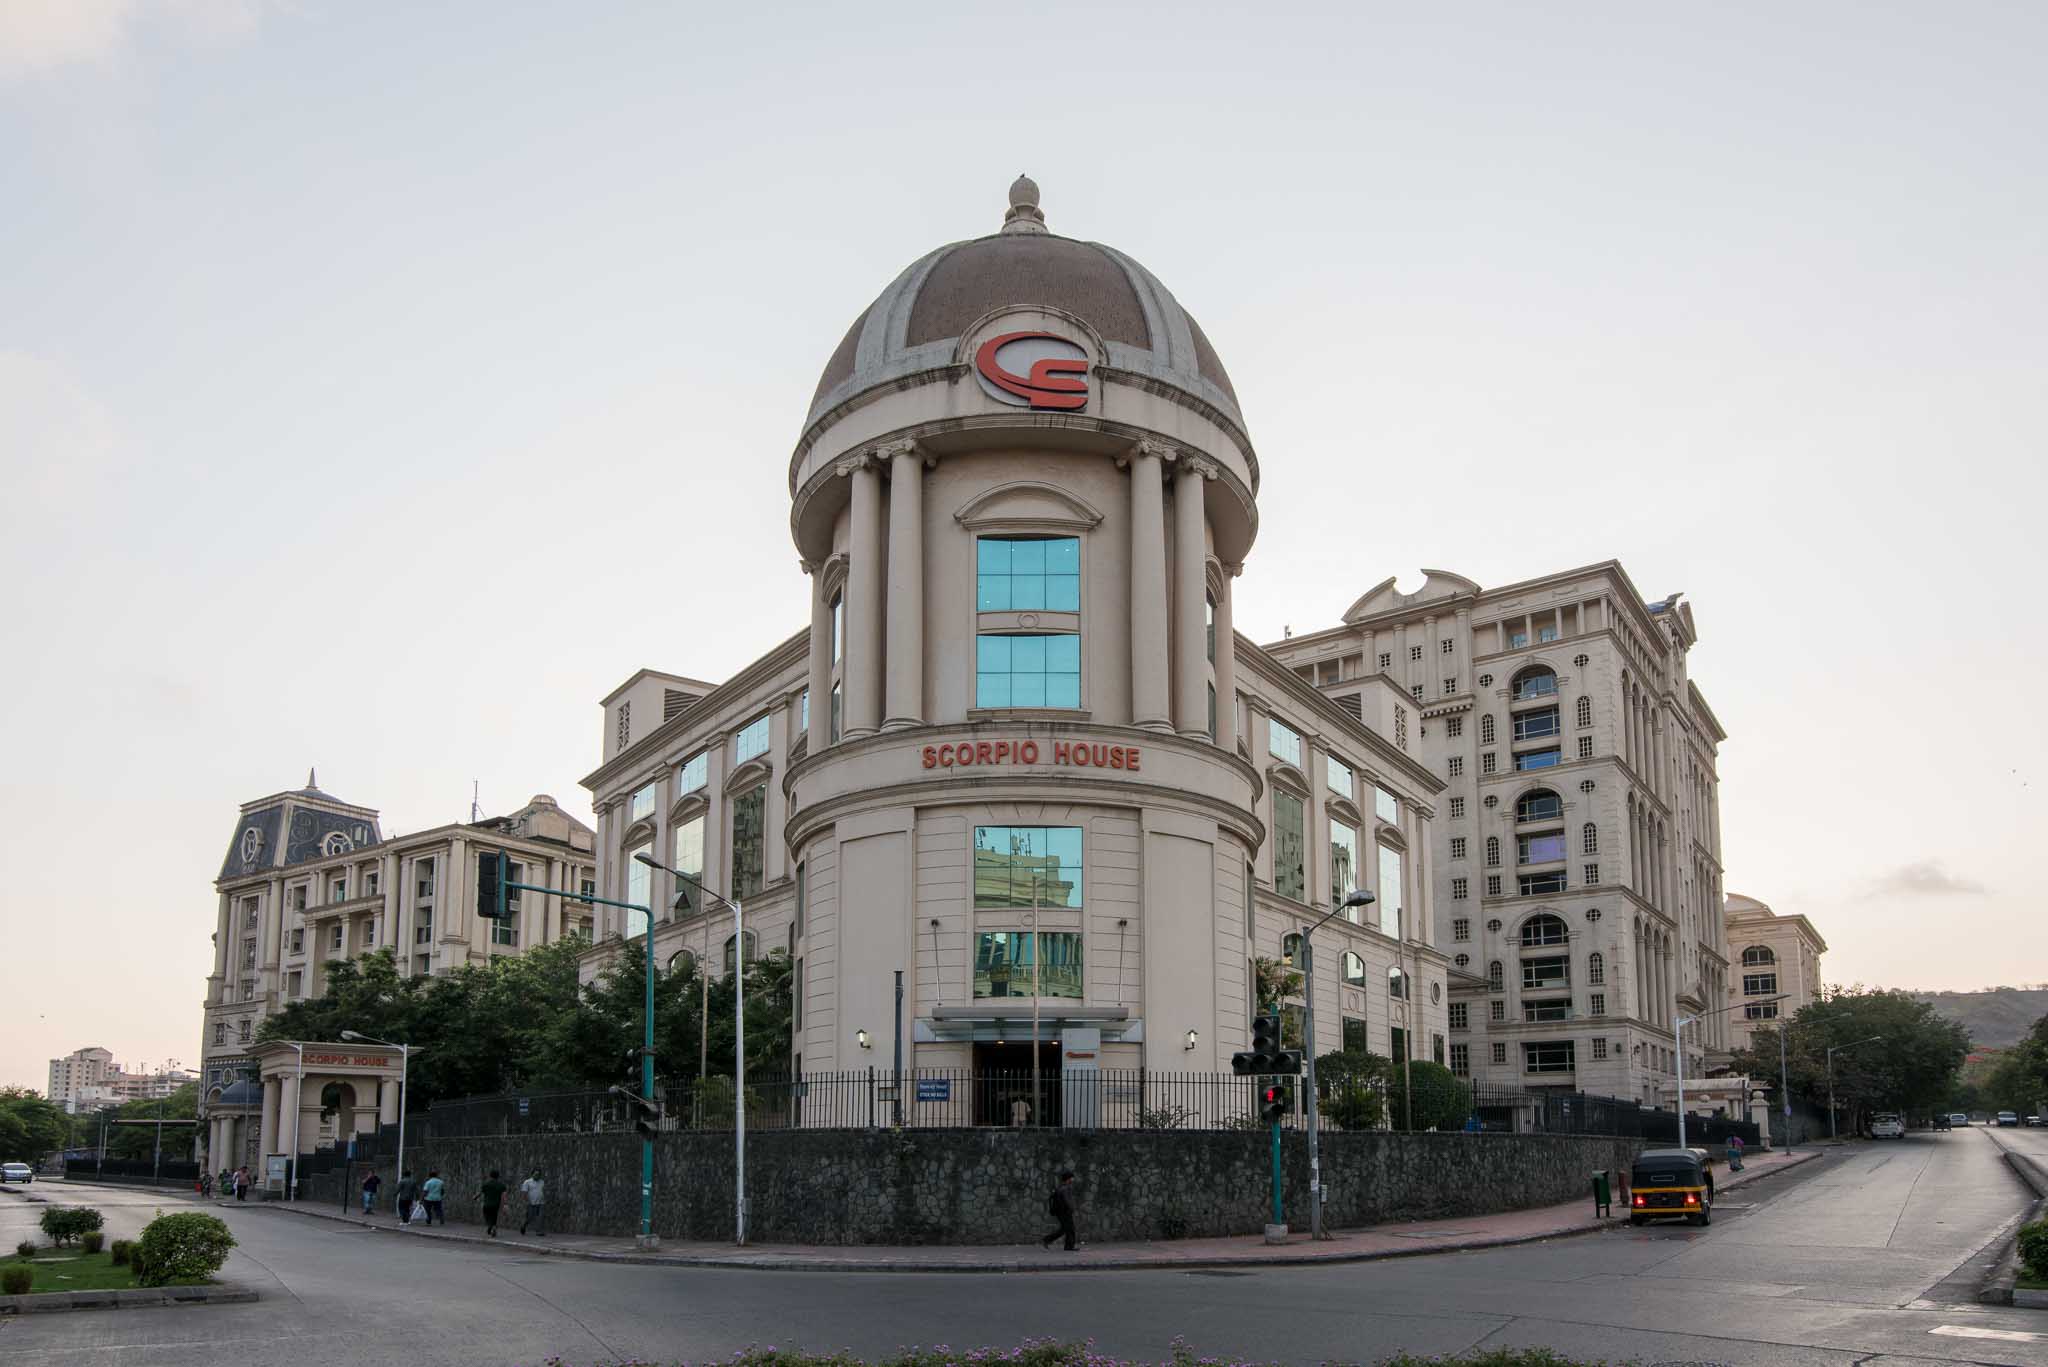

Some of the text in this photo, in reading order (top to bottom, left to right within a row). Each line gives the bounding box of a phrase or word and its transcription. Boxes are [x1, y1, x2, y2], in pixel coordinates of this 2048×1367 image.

[922, 740, 1141, 771] SCORPIO HOUSE
[302, 1054, 389, 1066] SCORPIO HOUSE
